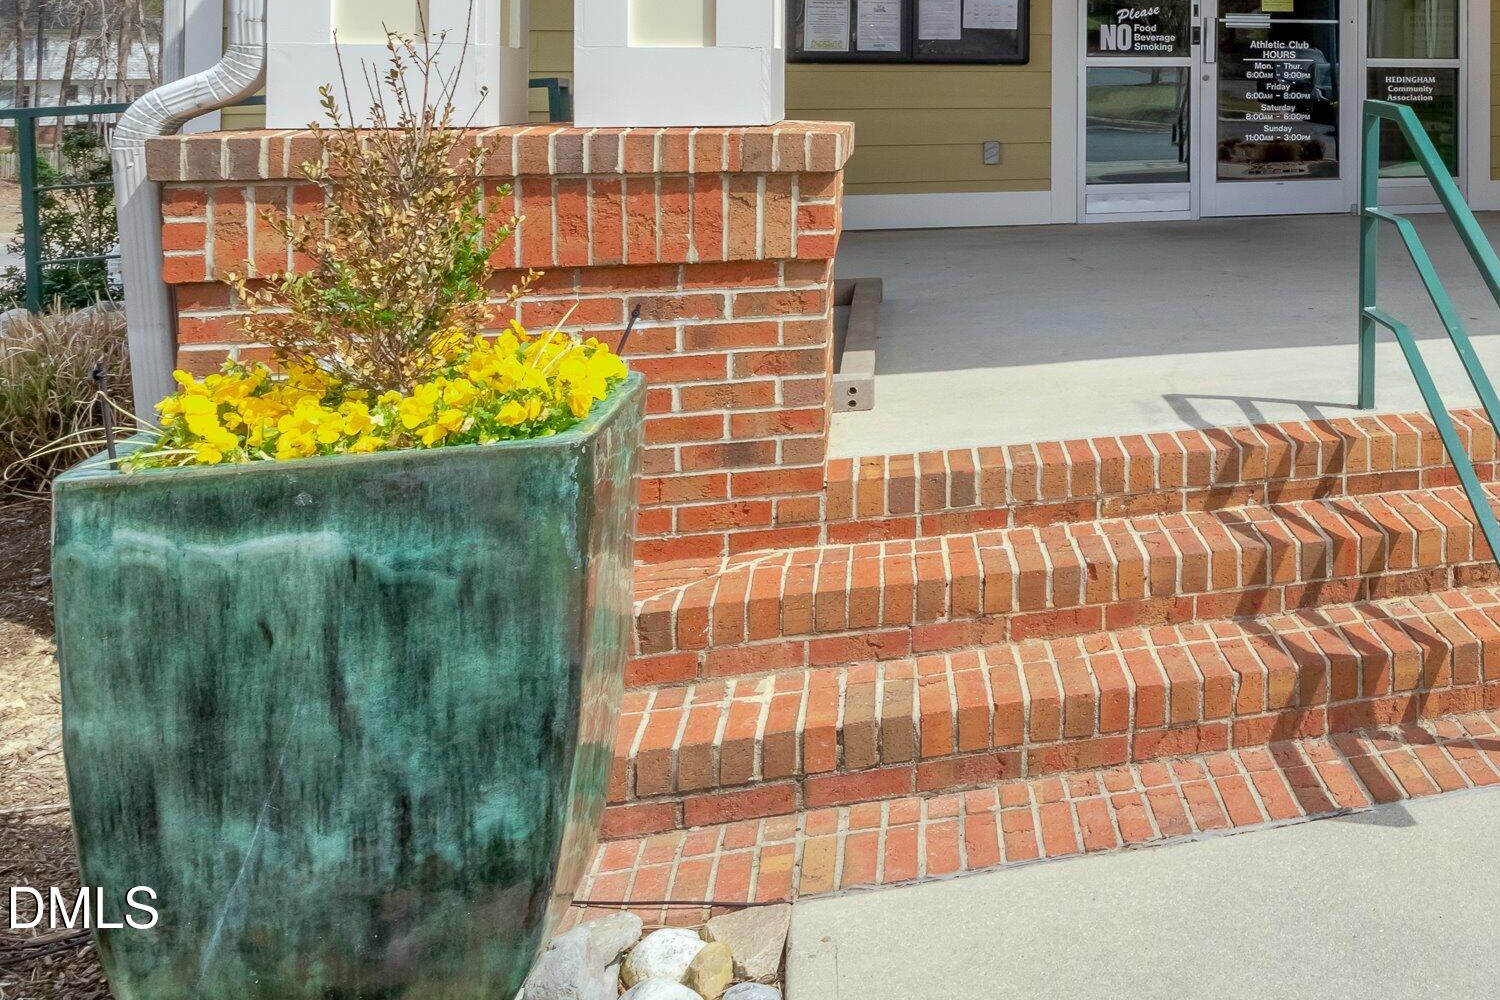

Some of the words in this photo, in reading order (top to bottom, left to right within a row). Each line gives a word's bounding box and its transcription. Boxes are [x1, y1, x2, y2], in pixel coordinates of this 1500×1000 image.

[1116, 6, 1160, 24] Please
[1133, 24, 1157, 32] Food
[1100, 23, 1133, 51] NO
[1133, 33, 1176, 43] Beverage
[1134, 43, 1173, 53] Smoking
[1250, 40, 1285, 49] Athletic
[1288, 40, 1310, 49] Club
[1262, 50, 1296, 59] HOURS
[1254, 62, 1274, 70] Mon.
[1284, 62, 1303, 70] Thur.
[1246, 71, 1274, 79] 6:00AM
[1283, 71, 1311, 79] 9:00PM
[1266, 82, 1291, 91] Friday
[1387, 84, 1434, 94] Community
[1245, 91, 1273, 100] 6:00AM
[1283, 92, 1311, 100] 8:00PM
[1260, 103, 1296, 112] Saturday
[1263, 124, 1293, 133] Sunday
[1245, 133, 1274, 141] 11:00AM
[1283, 133, 1311, 141] 3:00PM
